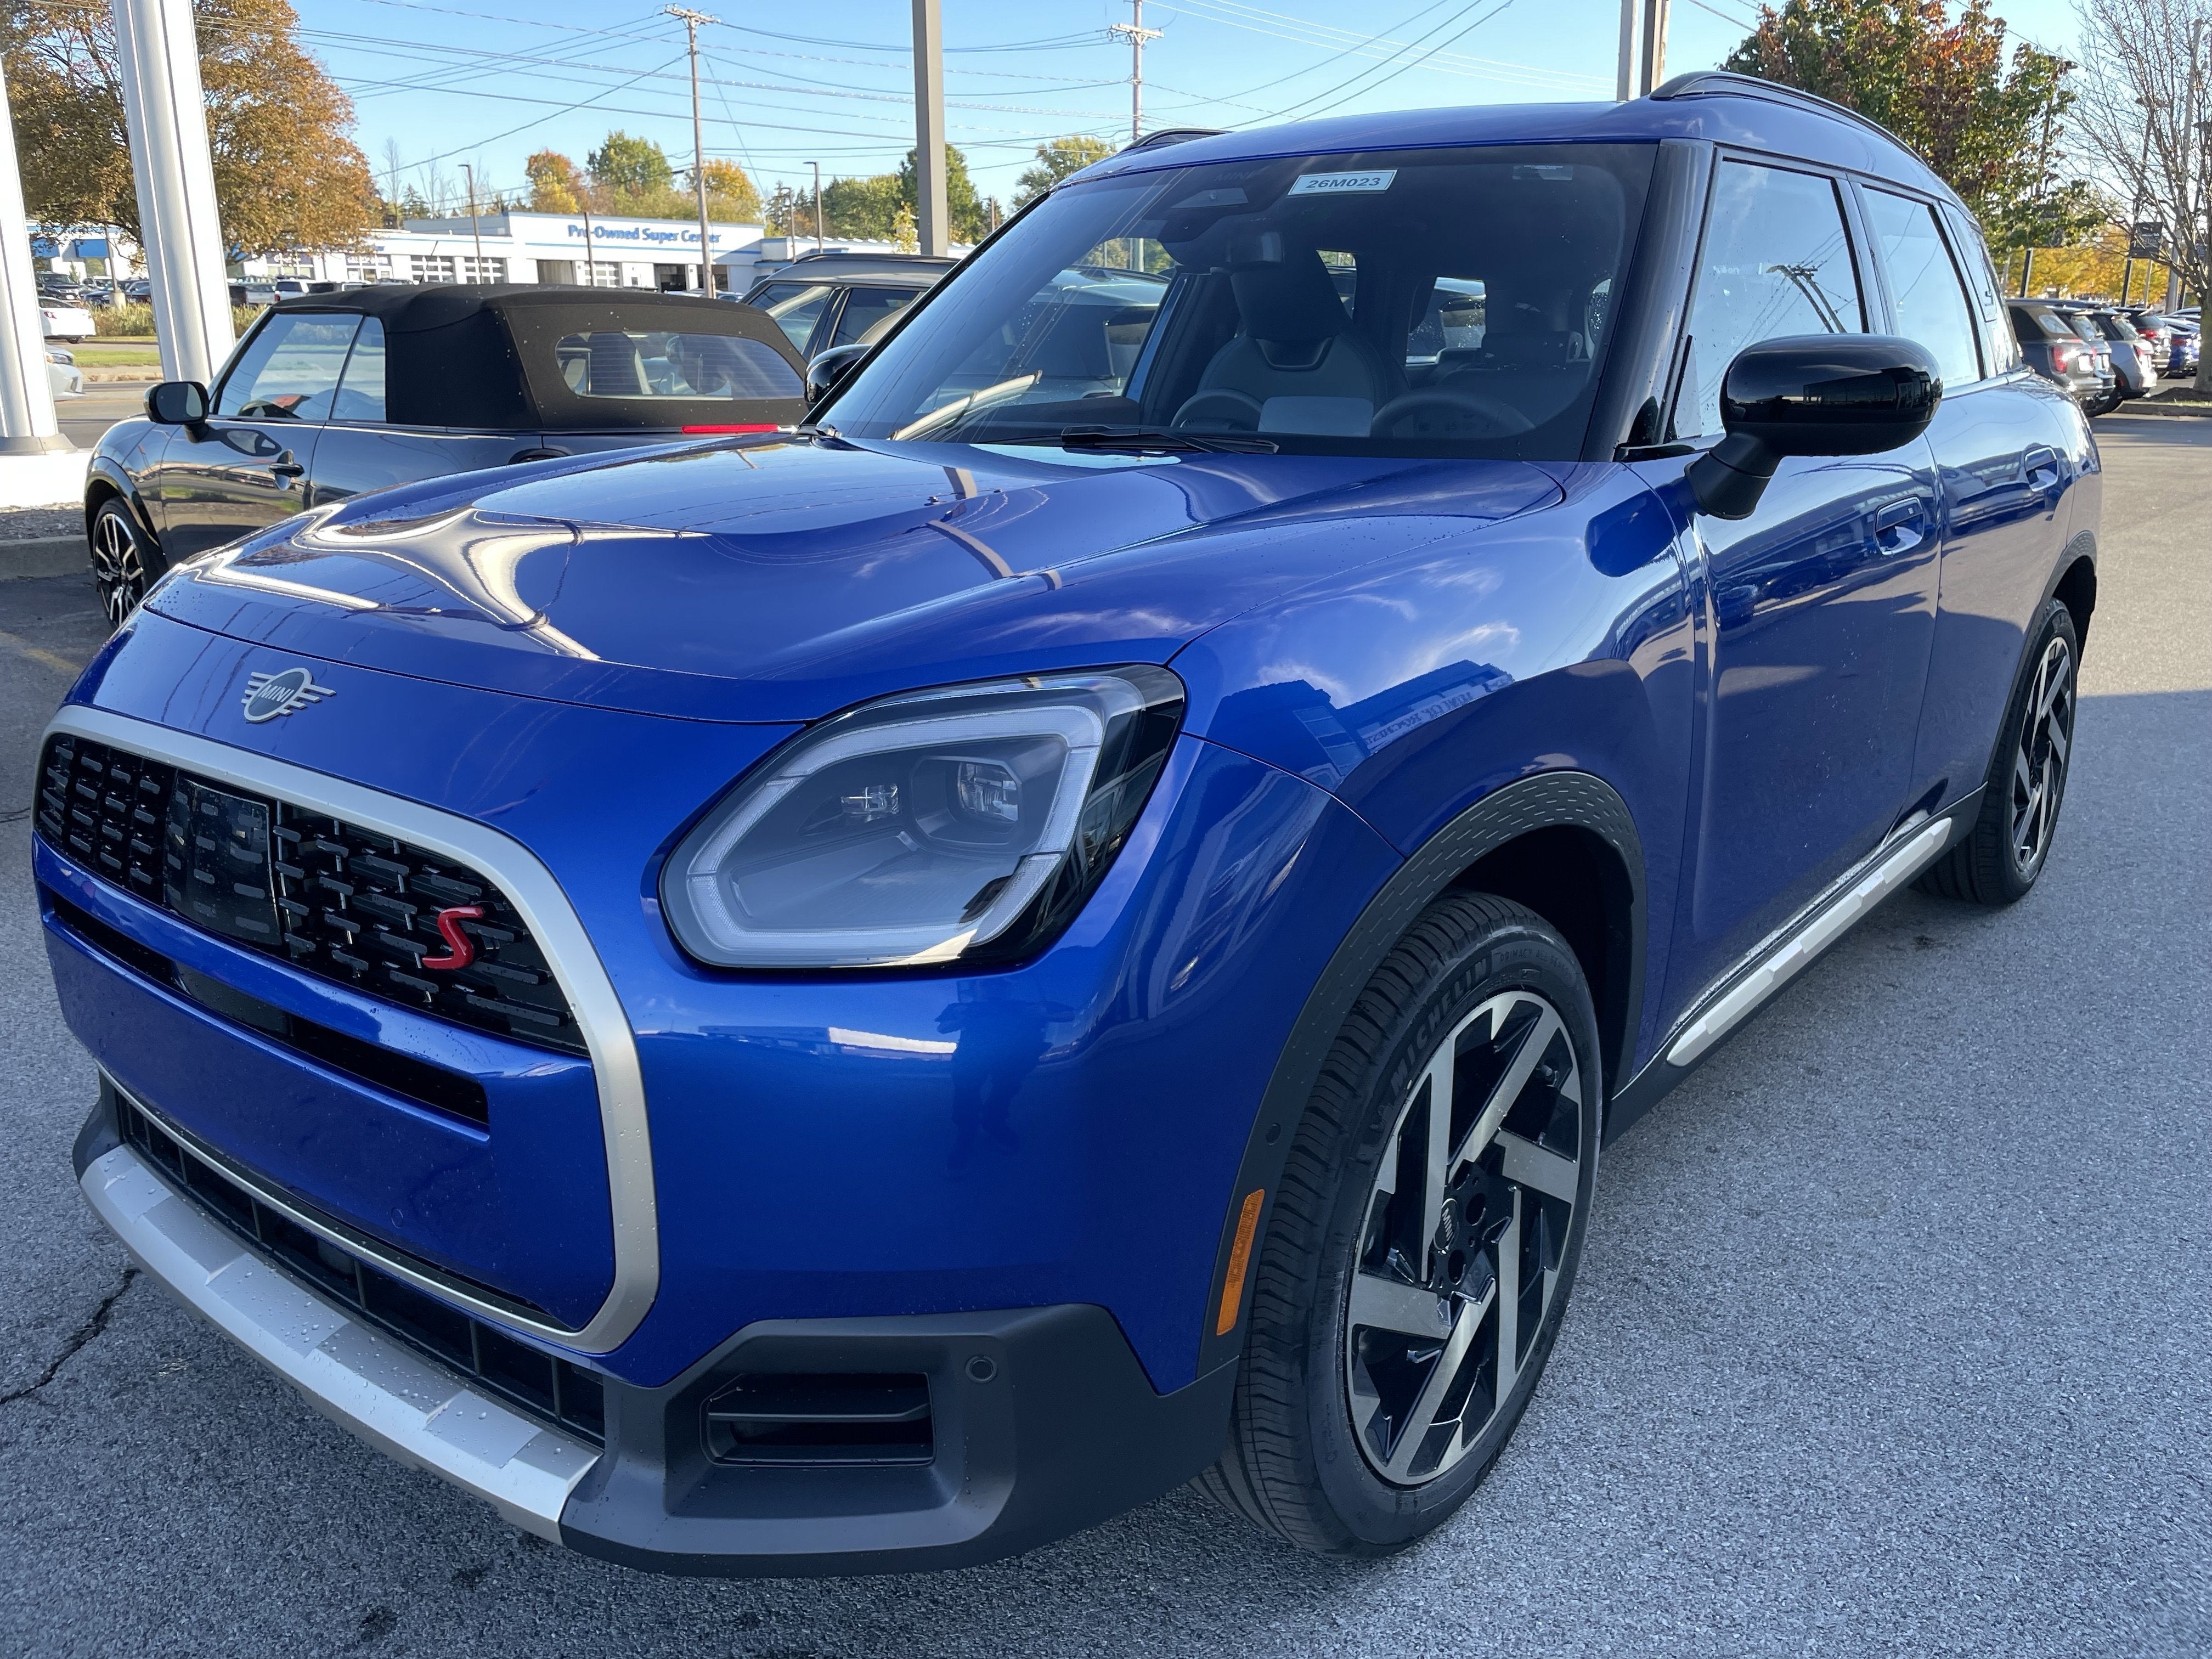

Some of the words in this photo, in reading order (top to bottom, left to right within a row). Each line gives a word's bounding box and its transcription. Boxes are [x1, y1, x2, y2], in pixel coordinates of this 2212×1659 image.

[1306, 177, 1381, 189] 26M023
[642, 228, 680, 245] Super
[681, 229, 721, 244] Cener
[258, 683, 295, 703] MINI
[421, 905, 486, 970] S
[1499, 948, 1533, 963] PRIMACY
[1390, 957, 1487, 1097] MICHELIN
[1442, 1207, 1453, 1242] MINI
